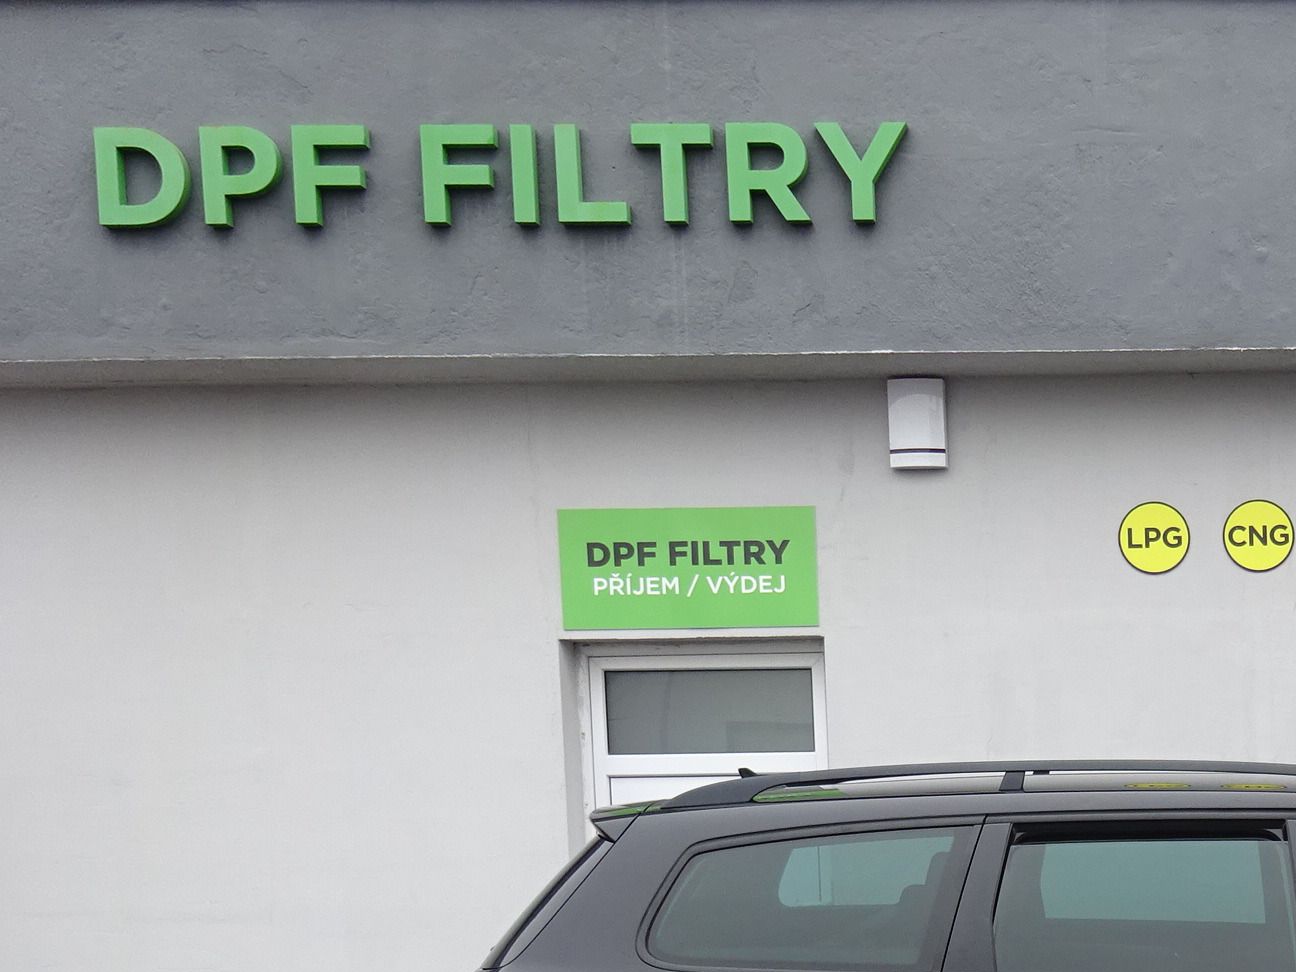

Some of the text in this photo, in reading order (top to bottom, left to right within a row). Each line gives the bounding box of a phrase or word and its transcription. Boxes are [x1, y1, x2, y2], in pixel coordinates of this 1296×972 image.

[93, 121, 909, 228] DPF FILTRY
[1127, 527, 1182, 548] LPG
[1228, 525, 1290, 547] CNG
[586, 539, 790, 567] DPF FILTRY
[593, 572, 786, 597] PŘÍJEM / VÝDEJ
